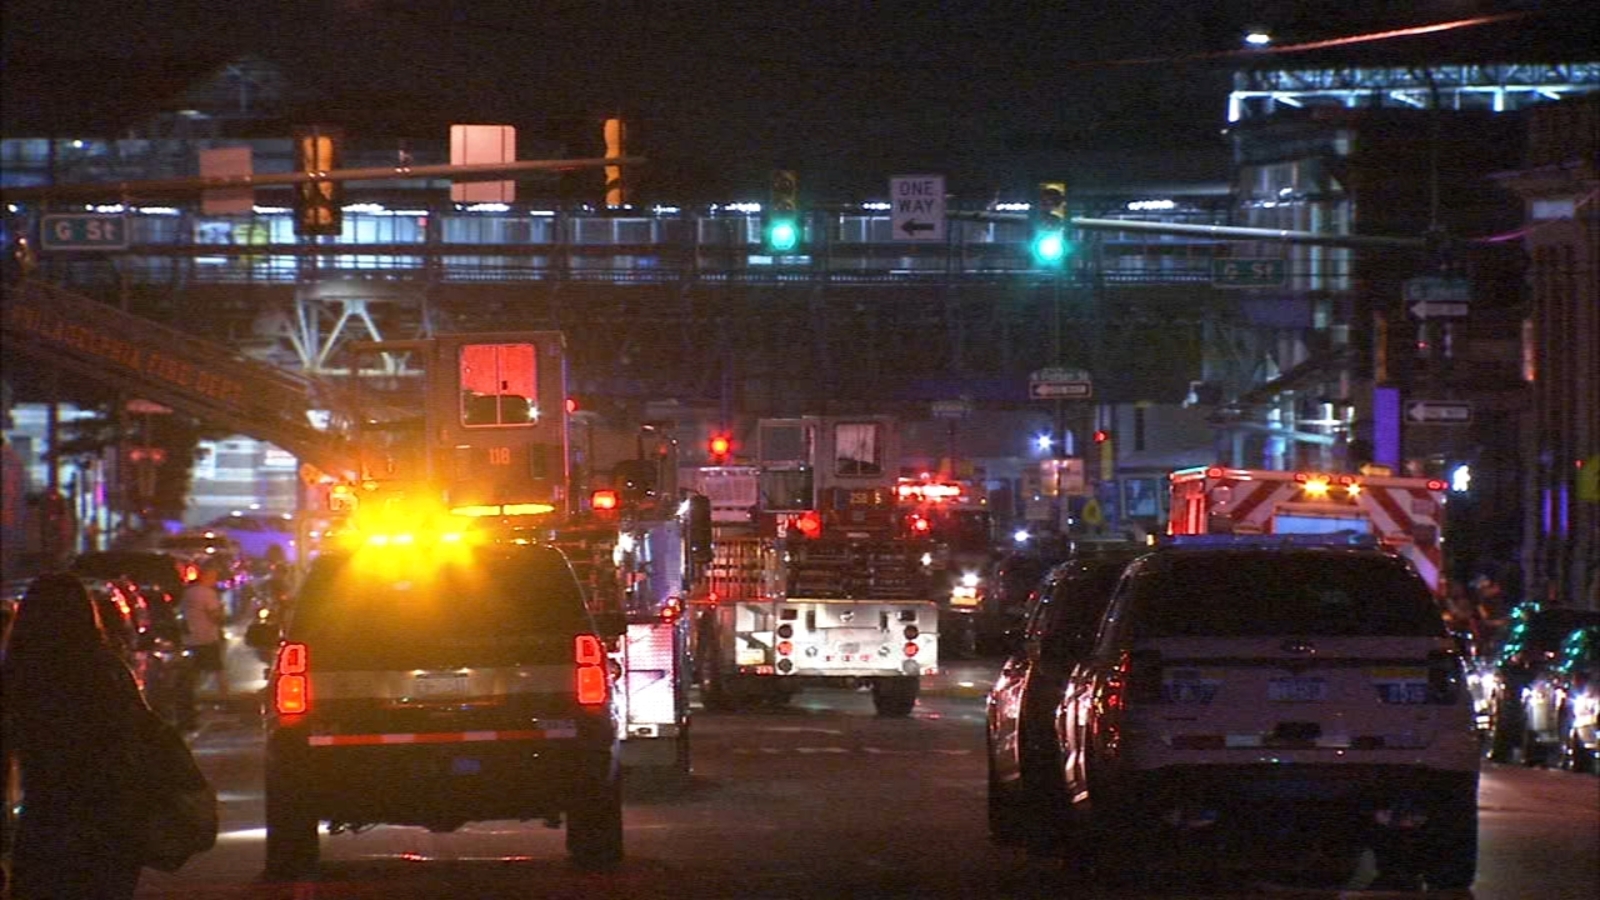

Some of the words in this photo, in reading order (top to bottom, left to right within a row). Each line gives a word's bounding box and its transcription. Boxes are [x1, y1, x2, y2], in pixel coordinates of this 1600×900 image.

[899, 180, 934, 196] ONE
[899, 199, 934, 213] WAY
[55, 220, 73, 241] G
[86, 219, 115, 241] St
